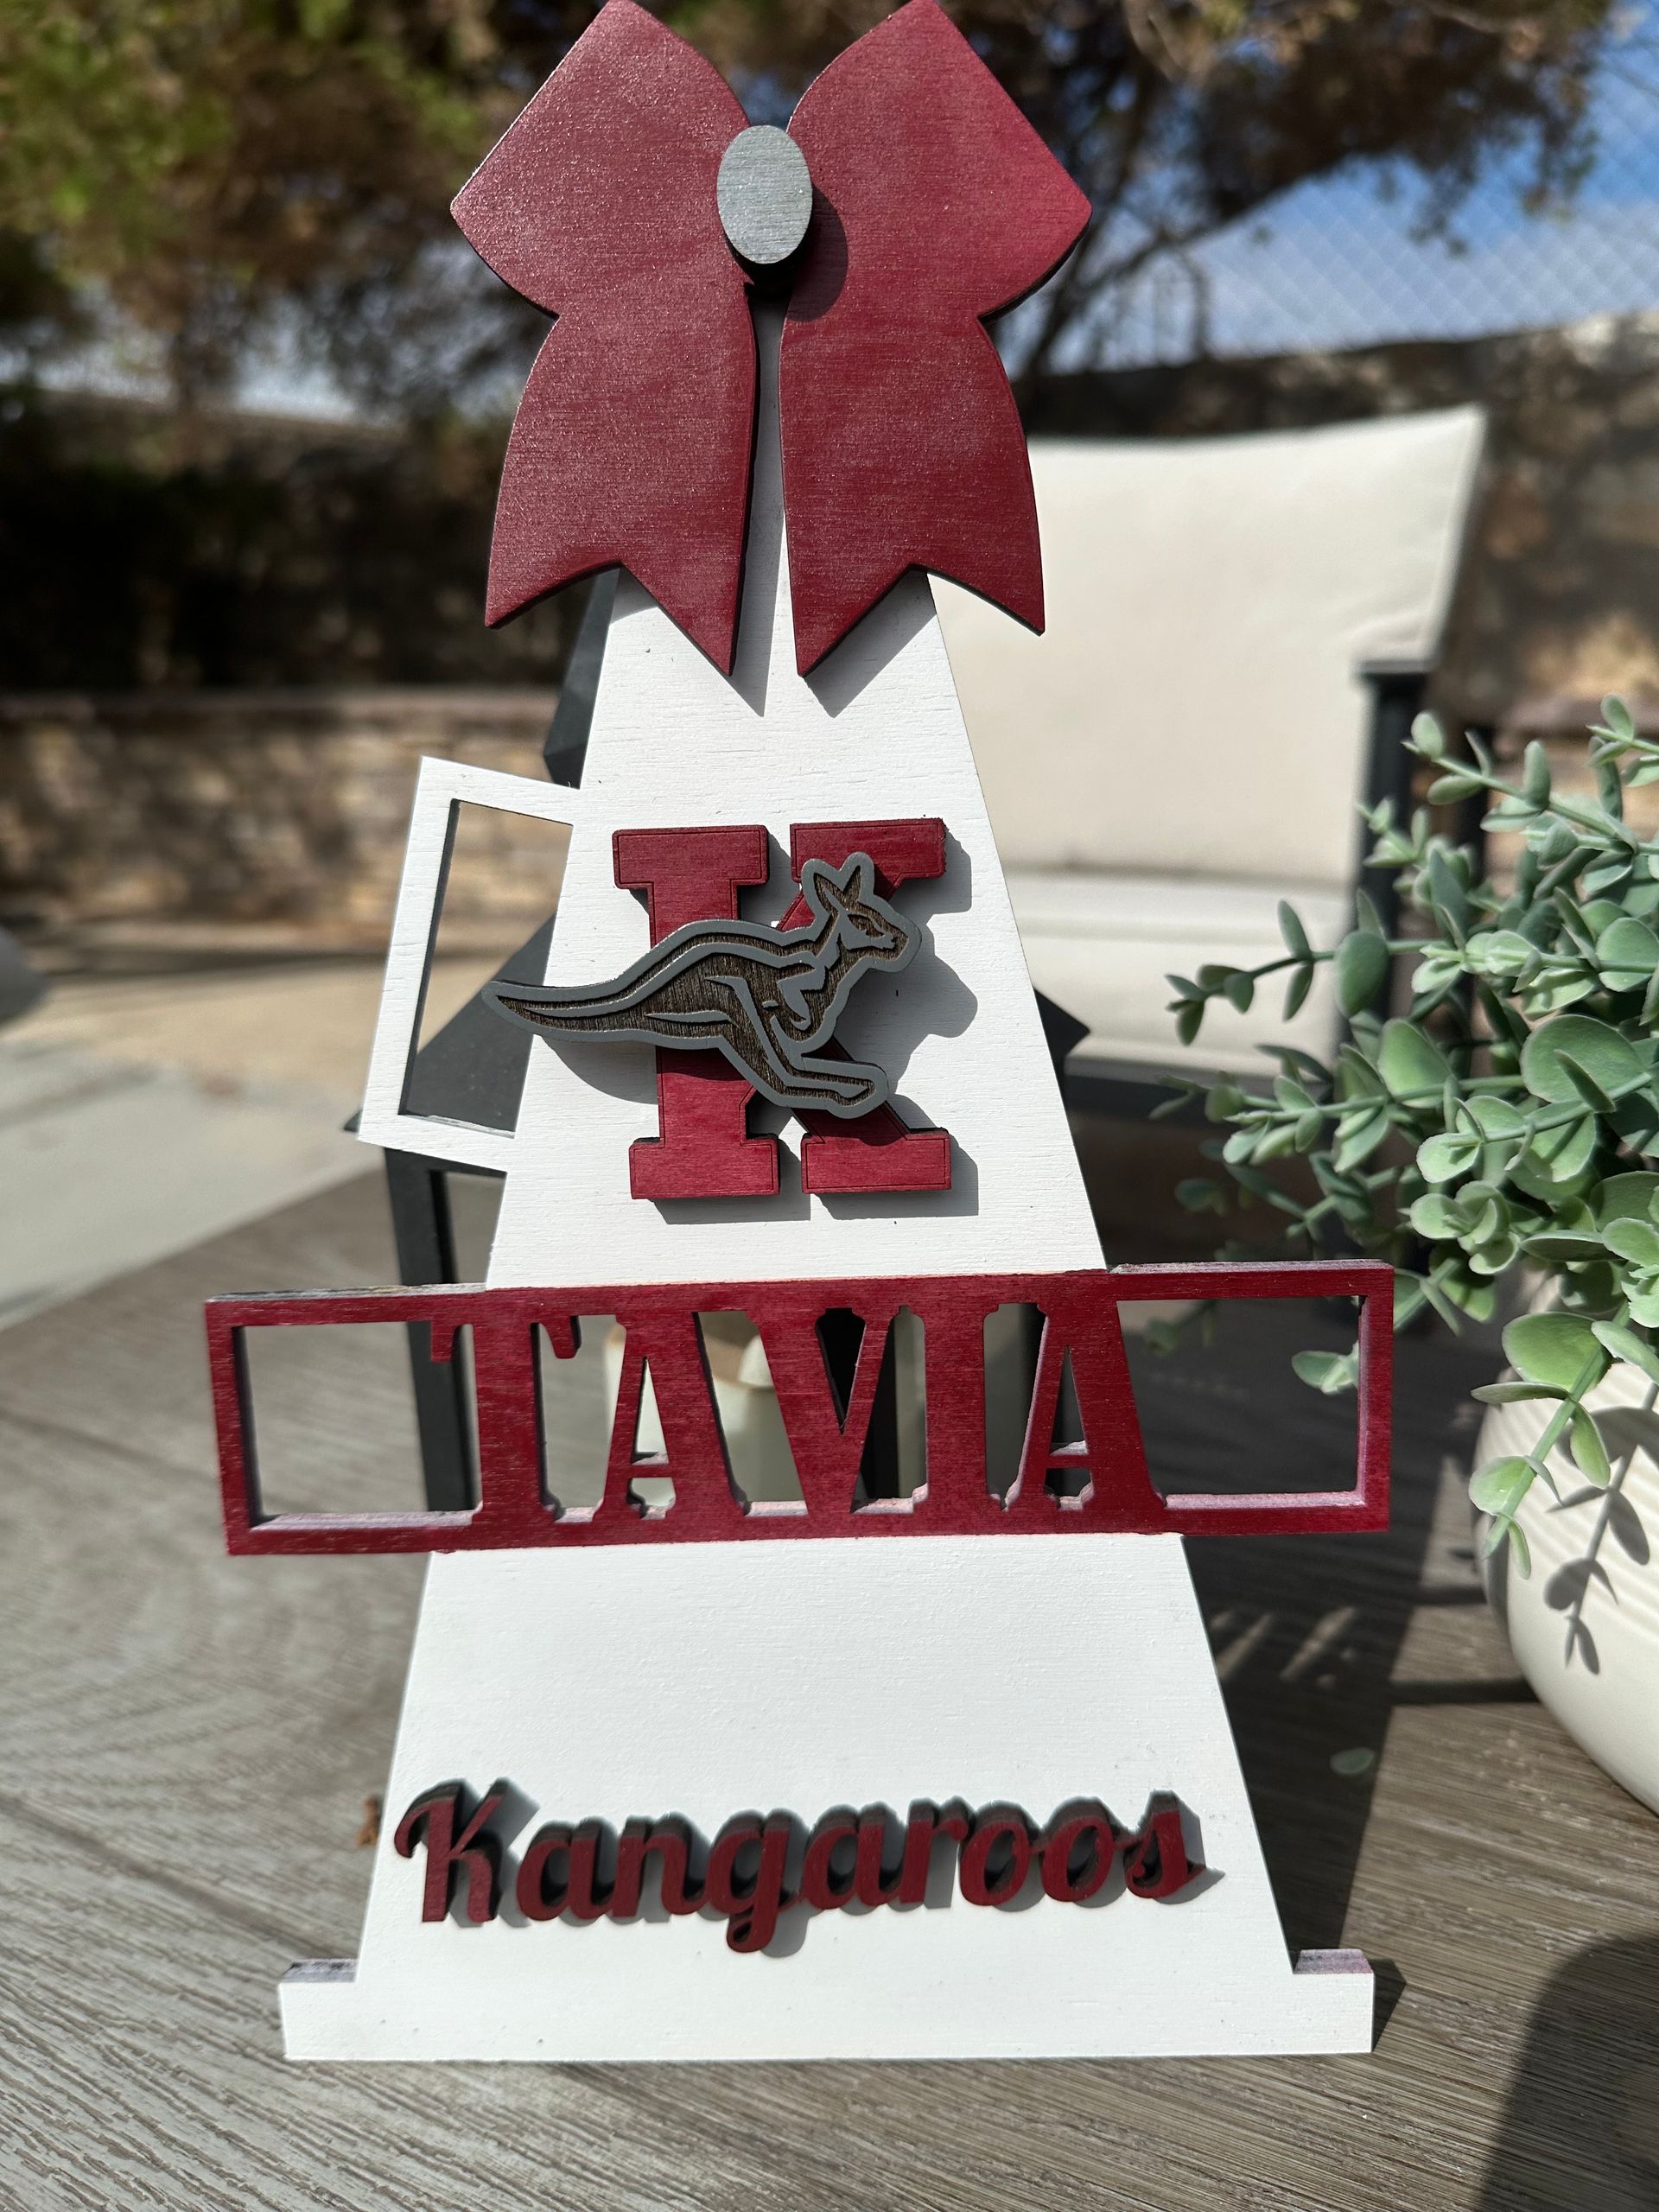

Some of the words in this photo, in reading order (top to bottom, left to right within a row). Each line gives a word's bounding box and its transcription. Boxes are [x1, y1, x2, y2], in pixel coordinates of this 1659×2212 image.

[612, 818, 951, 1200] K
[429, 1287, 1168, 1528] TAVIA
[394, 1778, 1206, 1955] Kangaroos
